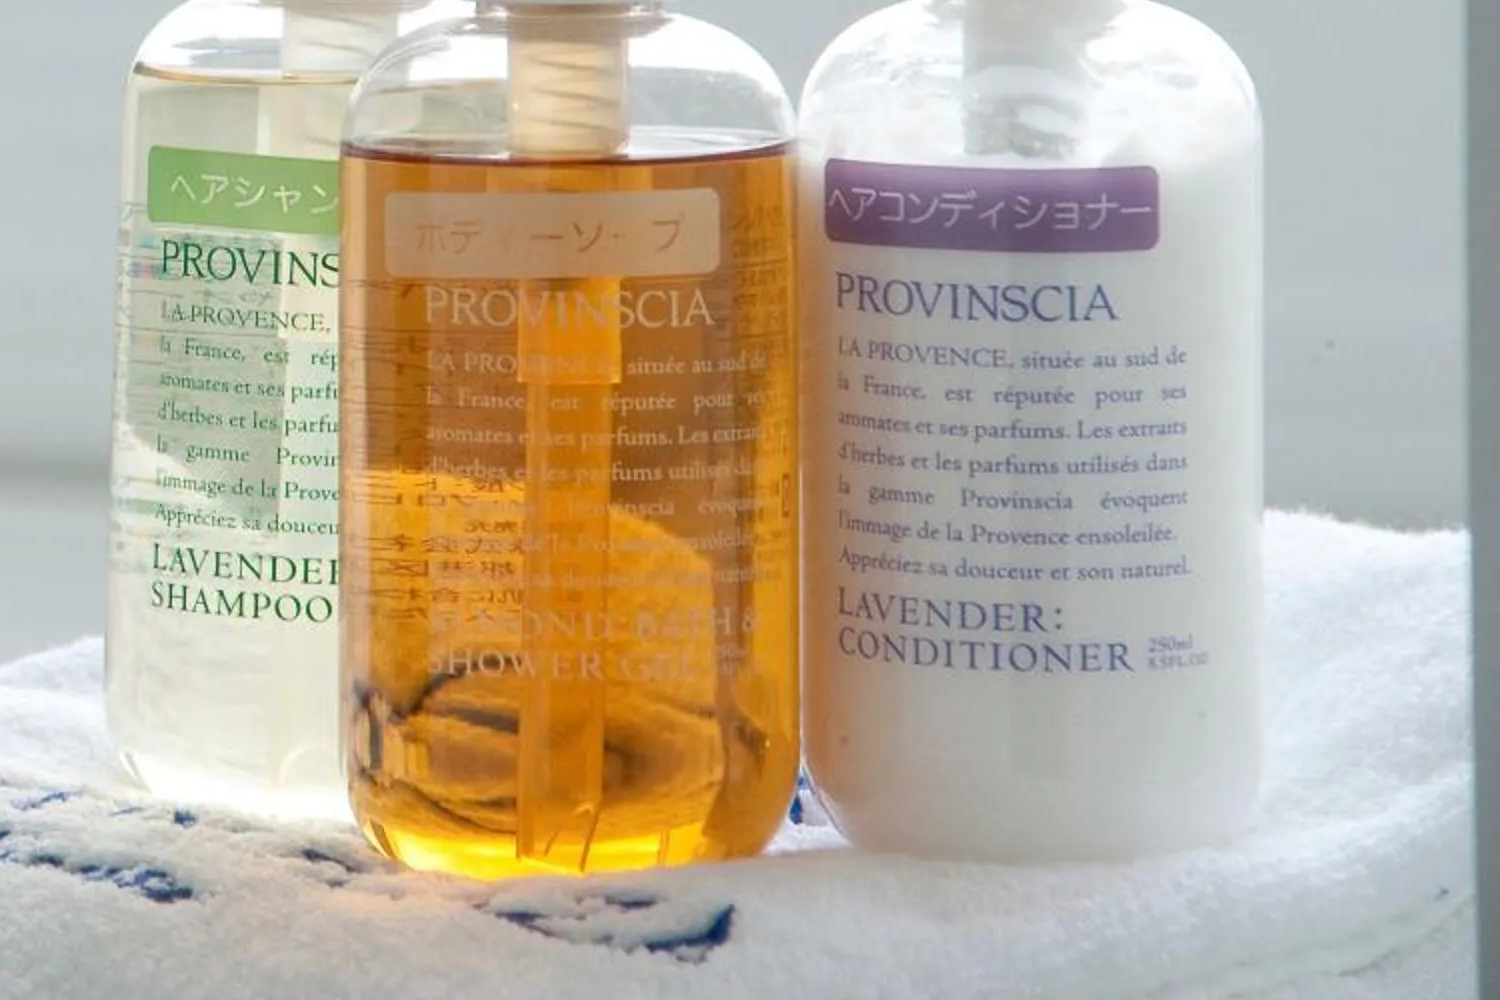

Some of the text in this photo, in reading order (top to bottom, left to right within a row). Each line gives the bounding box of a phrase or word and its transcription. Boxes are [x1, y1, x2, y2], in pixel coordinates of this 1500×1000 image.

[828, 186, 1152, 231] ヘアコンディショナー
[425, 286, 716, 330] PROVINSCIA
[836, 271, 1120, 323] PROVINSCIA
[162, 300, 331, 333] LA PROVENCE,
[185, 337, 245, 362] France,
[264, 348, 288, 363] est
[628, 354, 685, 375] située
[691, 360, 712, 374] au
[838, 336, 1187, 370] LA PROVENCE, située au sud de
[160, 372, 337, 404] aromates et ses parf
[837, 373, 849, 391] la
[945, 387, 972, 402] est
[994, 387, 1076, 410] réputée
[1096, 389, 1144, 410] pour
[1161, 385, 1187, 400] ses
[157, 402, 223, 426] d'herbes
[229, 414, 246, 429] et
[252, 411, 277, 429] les
[838, 411, 1187, 447] aromates et ses parfums. Les extraits
[427, 424, 513, 446] aromates
[678, 424, 709, 445] Les
[186, 444, 250, 463] gamme
[838, 441, 1187, 478] d'herbes et les parfums utilisés dans
[156, 467, 226, 498] l'immage
[231, 478, 254, 497] de
[261, 481, 277, 497] la
[838, 475, 1188, 512] la gamme Provinscia évoquent
[154, 503, 236, 529] Appréciez
[242, 518, 262, 531] sa
[838, 509, 912, 539] l'immage
[917, 520, 940, 541] de
[946, 521, 964, 542] la
[970, 522, 1070, 546] Provence
[838, 544, 1192, 581] Appréciez sa douceur et son naturel.
[151, 581, 332, 623] SHAMPOO
[837, 586, 1064, 632] LAVENDER:
[838, 627, 1137, 672] CONDITIONER
